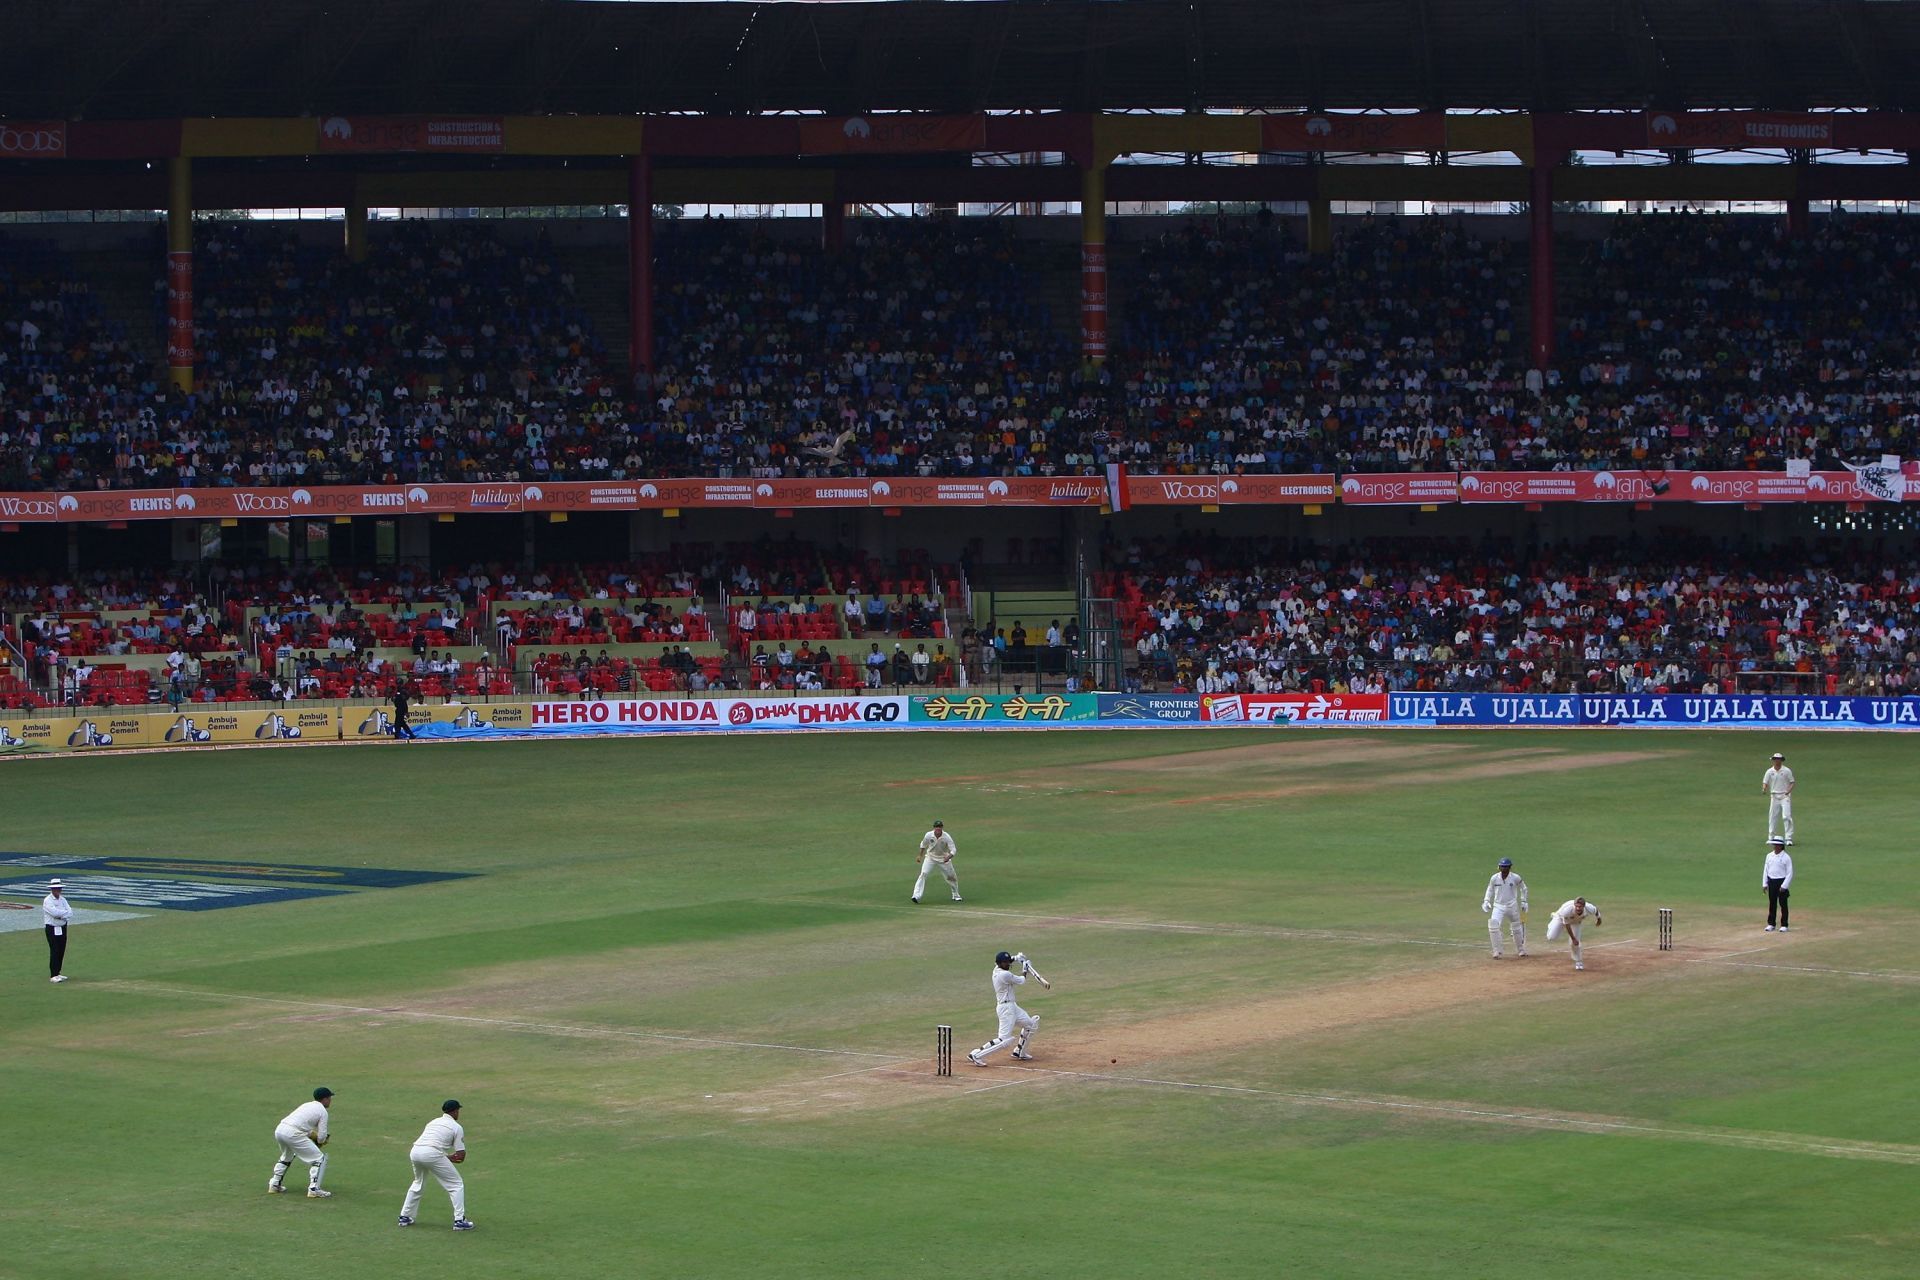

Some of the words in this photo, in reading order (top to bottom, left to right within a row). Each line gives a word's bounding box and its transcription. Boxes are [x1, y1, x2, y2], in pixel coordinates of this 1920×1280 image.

[428, 121, 493, 132] CONSTRUCTION
[1745, 122, 1829, 139] ELECTRONICS
[428, 134, 502, 145] INFRASTRUCTURE
[1409, 480, 1450, 488] CONSTRUCTION
[1528, 478, 1570, 486] CONSTRUCTION
[590, 488, 631, 496] CONSTRUCTION
[705, 485, 745, 493] CONSTRUCTION
[937, 484, 979, 492] CONSTRUCTION
[1049, 482, 1101, 502] holidays
[1161, 482, 1217, 498] WOODS
[1280, 486, 1333, 496] ELECTRONICS
[1409, 488, 1457, 496] INFRASTRUCTURE
[1528, 486, 1576, 495] INFRASTRUCTURE
[1758, 486, 1806, 494] INFRASTRUCTURE
[705, 492, 752, 501] INFRASTRUCTURE
[815, 488, 868, 499] ELECTRONICS
[937, 492, 985, 500] INFRASTRUCTURE
[130, 497, 172, 511] EVENTS
[233, 493, 289, 511] WOODS
[362, 493, 404, 506] EVENTS
[470, 489, 521, 510] holidays
[590, 495, 637, 504] INFRASTRUCTURE
[0, 497, 55, 516] WOODS
[1149, 700, 1199, 709] FRONTIERS
[407, 709, 432, 718] mbuja
[492, 709, 522, 717] Ambuja
[532, 703, 609, 724] HERO
[618, 701, 718, 722] HONDA
[731, 706, 746, 722] 25
[755, 701, 798, 721] DHAK
[798, 701, 861, 723] DHAK
[863, 702, 900, 722] GO
[1157, 710, 1191, 718] GROUP
[1394, 697, 1475, 720] UJALA
[1492, 698, 1574, 722] UJALA
[1584, 698, 1666, 723] UJALA
[1683, 699, 1767, 723] UJALA
[1773, 700, 1855, 723] UJALA
[1871, 701, 1920, 724] UJA
[208, 716, 238, 724] Ambuja
[298, 713, 328, 721] Ambuja
[407, 716, 432, 725] ement
[492, 715, 522, 723] Cement
[22, 724, 51, 732] Ambuja
[110, 720, 139, 728] Ambuja
[298, 720, 328, 728] Cement
